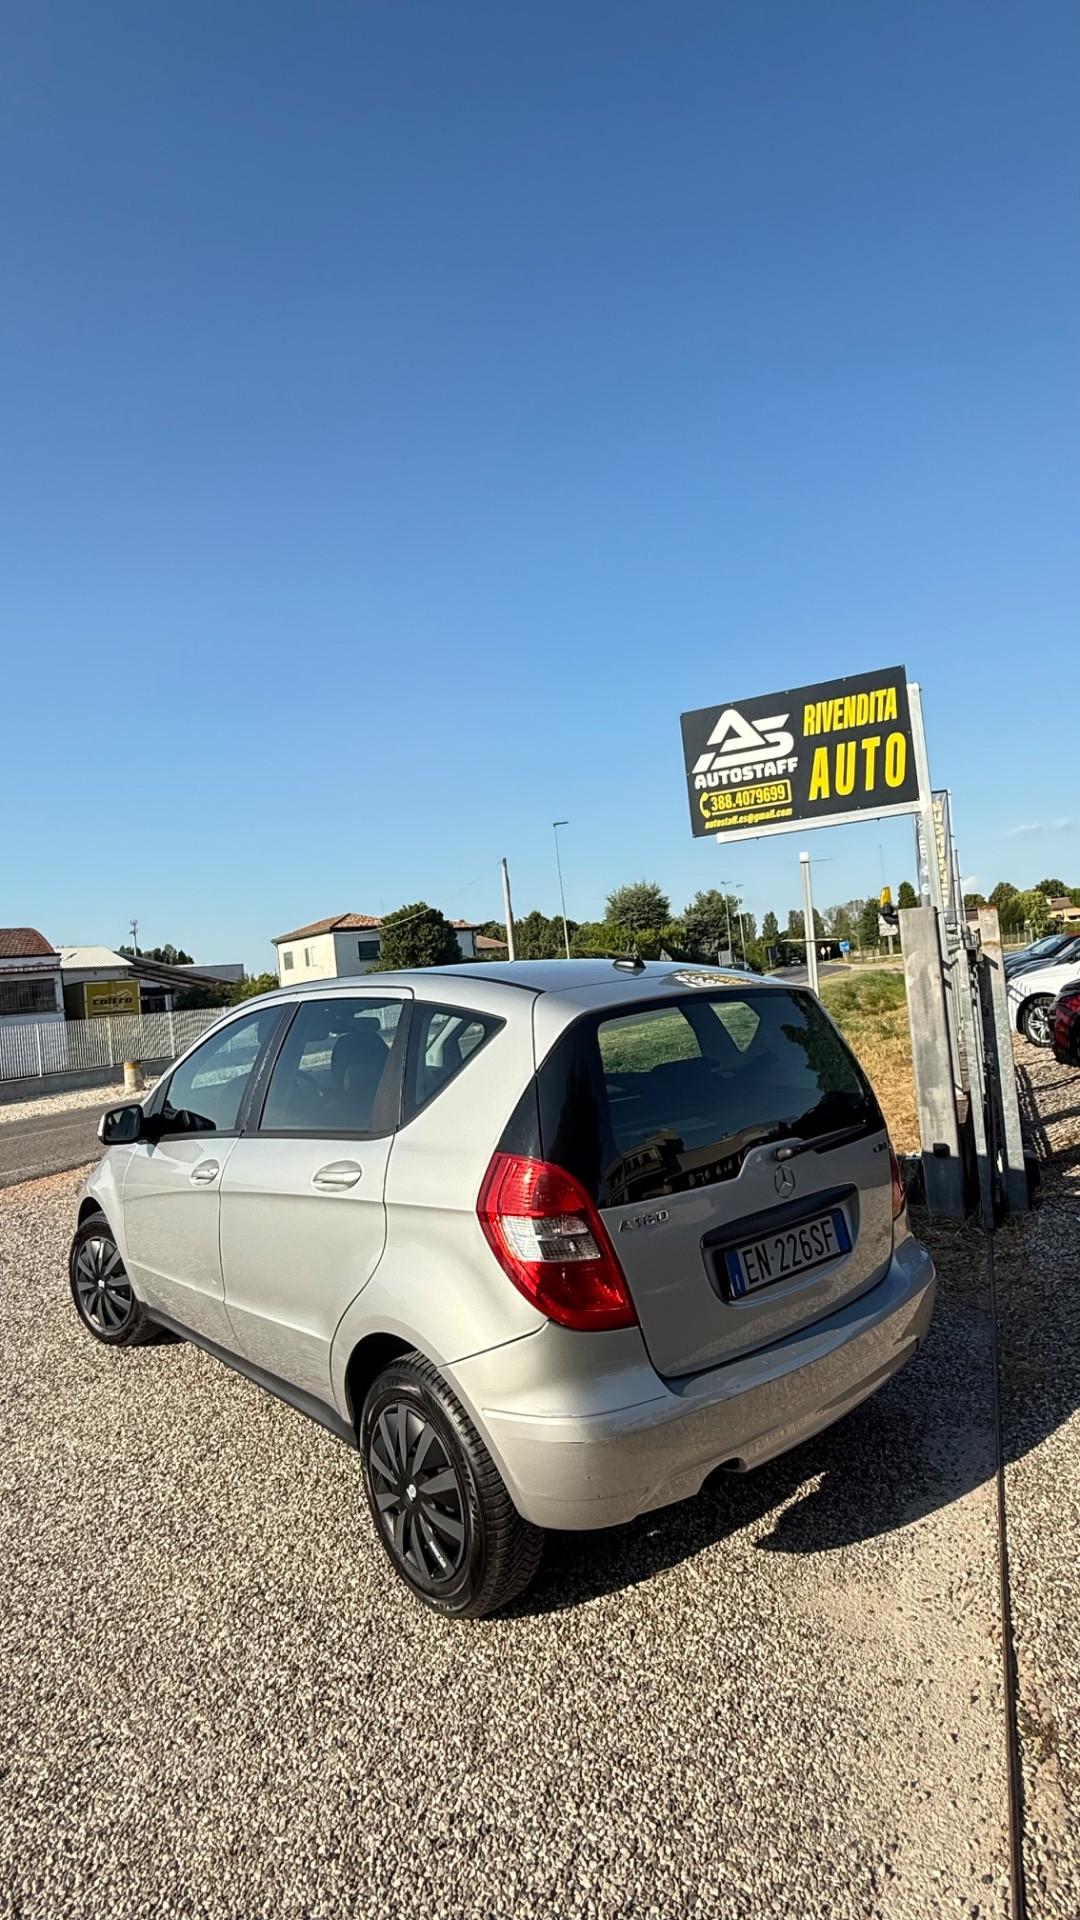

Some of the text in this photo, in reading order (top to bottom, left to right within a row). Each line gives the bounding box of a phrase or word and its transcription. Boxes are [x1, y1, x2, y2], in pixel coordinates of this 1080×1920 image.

[803, 687, 897, 736] RIVENDITA
[694, 757, 799, 790] AUTOSTAFF
[808, 732, 906, 801] AUTO
[711, 784, 785, 811] 388.4079699
[704, 808, 793, 829] autostaff.es@gmail.com
